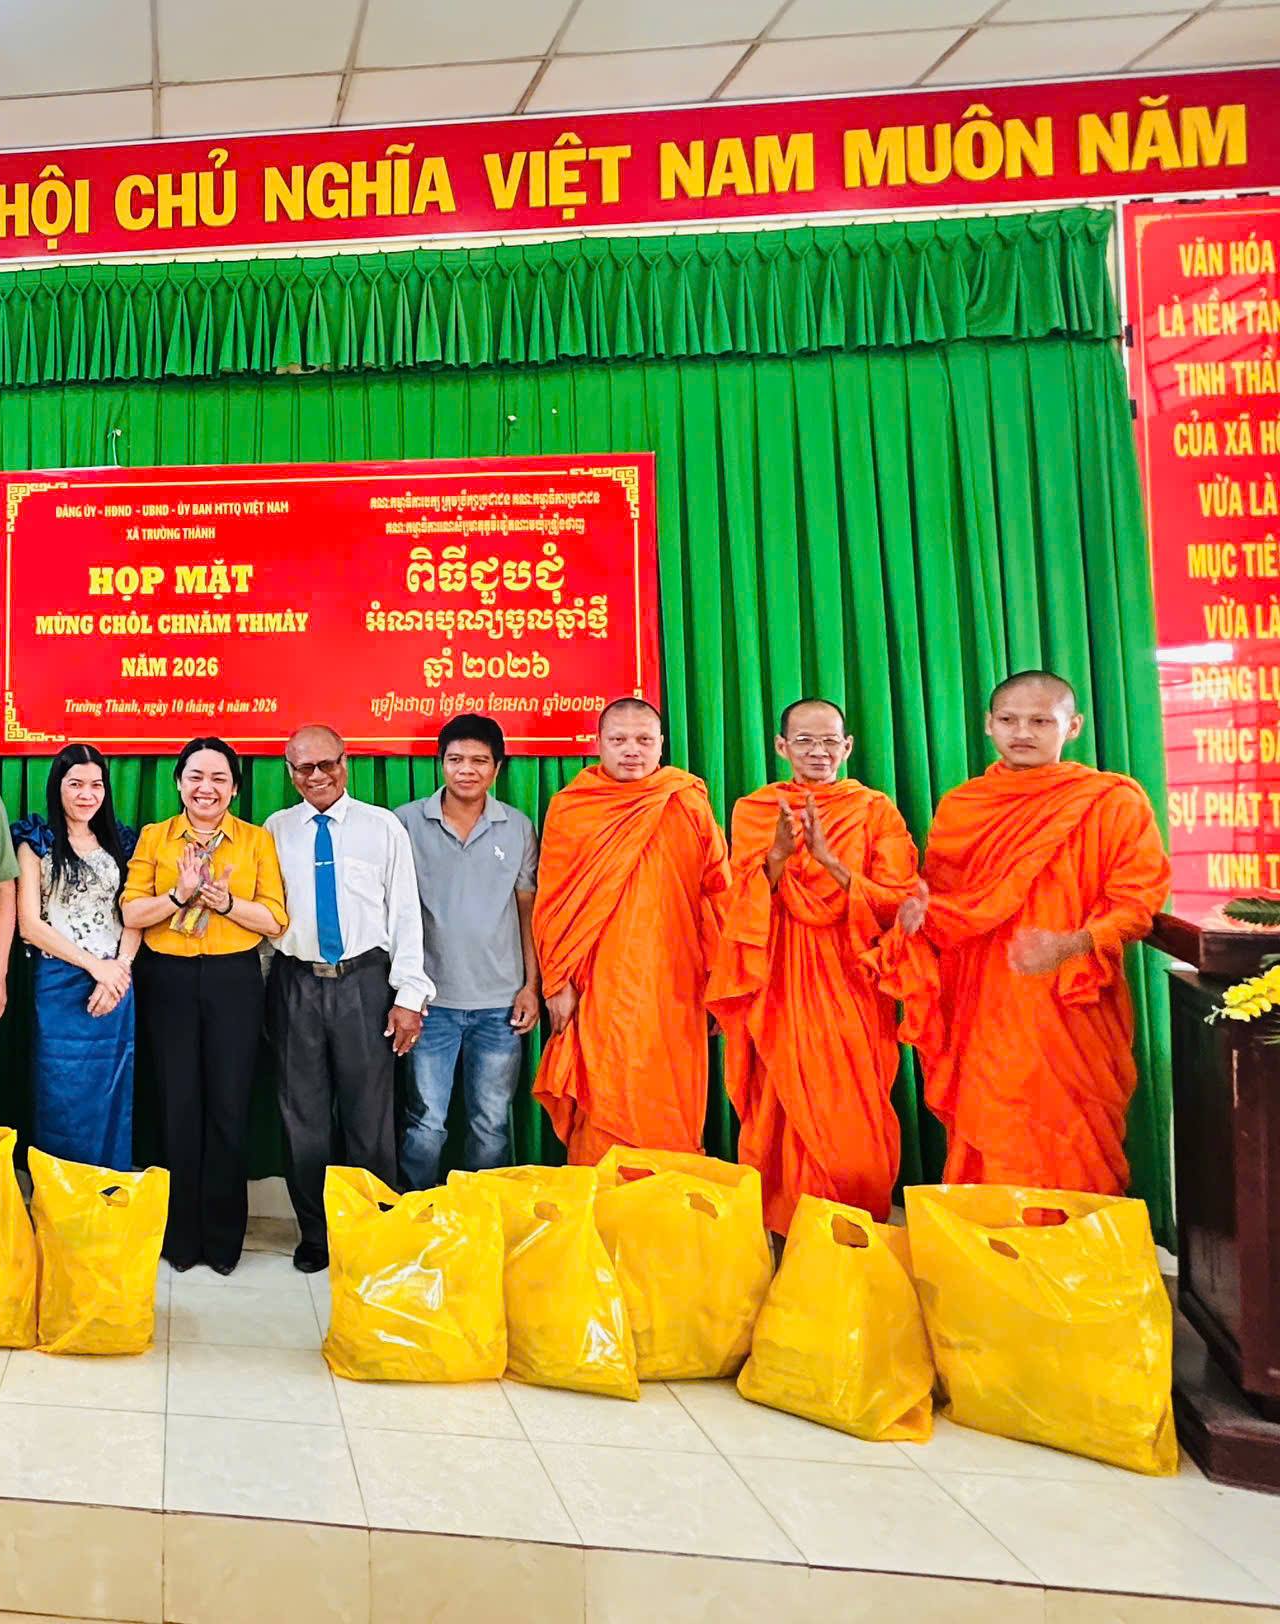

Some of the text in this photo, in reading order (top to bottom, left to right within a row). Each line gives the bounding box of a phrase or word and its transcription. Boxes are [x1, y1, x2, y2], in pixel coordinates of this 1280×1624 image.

[114, 147, 237, 231] CHỦ
[264, 142, 457, 223] NGHĨA
[483, 131, 632, 220] VIỆT
[660, 132, 816, 201] NAM
[843, 103, 1054, 189] MUÔN
[1078, 94, 1248, 175] NĂM
[1179, 231, 1276, 278] VĂN HÓA
[1158, 295, 1186, 338] LÀ
[1192, 287, 1238, 336] NỀN
[1174, 345, 1280, 397] TINH THẦ
[1174, 409, 1219, 457] CỦA
[1224, 412, 1254, 456] XÃ
[56, 503, 82, 518] ĐẢNG
[84, 503, 97, 517] ỦY
[142, 504, 170, 517] UBND
[178, 500, 191, 516] ỦY
[192, 503, 213, 516] BAN
[215, 502, 241, 517] MTTQ
[243, 500, 265, 516] VIỆT
[267, 501, 289, 514] NAM
[1199, 471, 1279, 518] VỪA LÀ
[126, 524, 216, 541] XÃ TRƯỜNG THÀNH
[89, 558, 254, 601] HỌP MẶT
[406, 542, 564, 605] ពិធីជួបជុំ
[1187, 532, 1280, 586] MỤC TIÊ
[158, 610, 232, 634] CHNĂM
[236, 609, 309, 633] THMÂY
[1203, 594, 1280, 640] VỪA LÀ
[121, 653, 219, 677] NĂM 2026
[423, 647, 550, 688] ឆ្នាំ ២០២៦
[64, 698, 278, 717] Trường Thành, ngày 10 tháng 4 năm 2026
[1193, 719, 1254, 764] THÚC
[1168, 785, 1199, 834] SỰ
[1204, 783, 1263, 828] PHÁT
[1207, 853, 1261, 889] KINH
